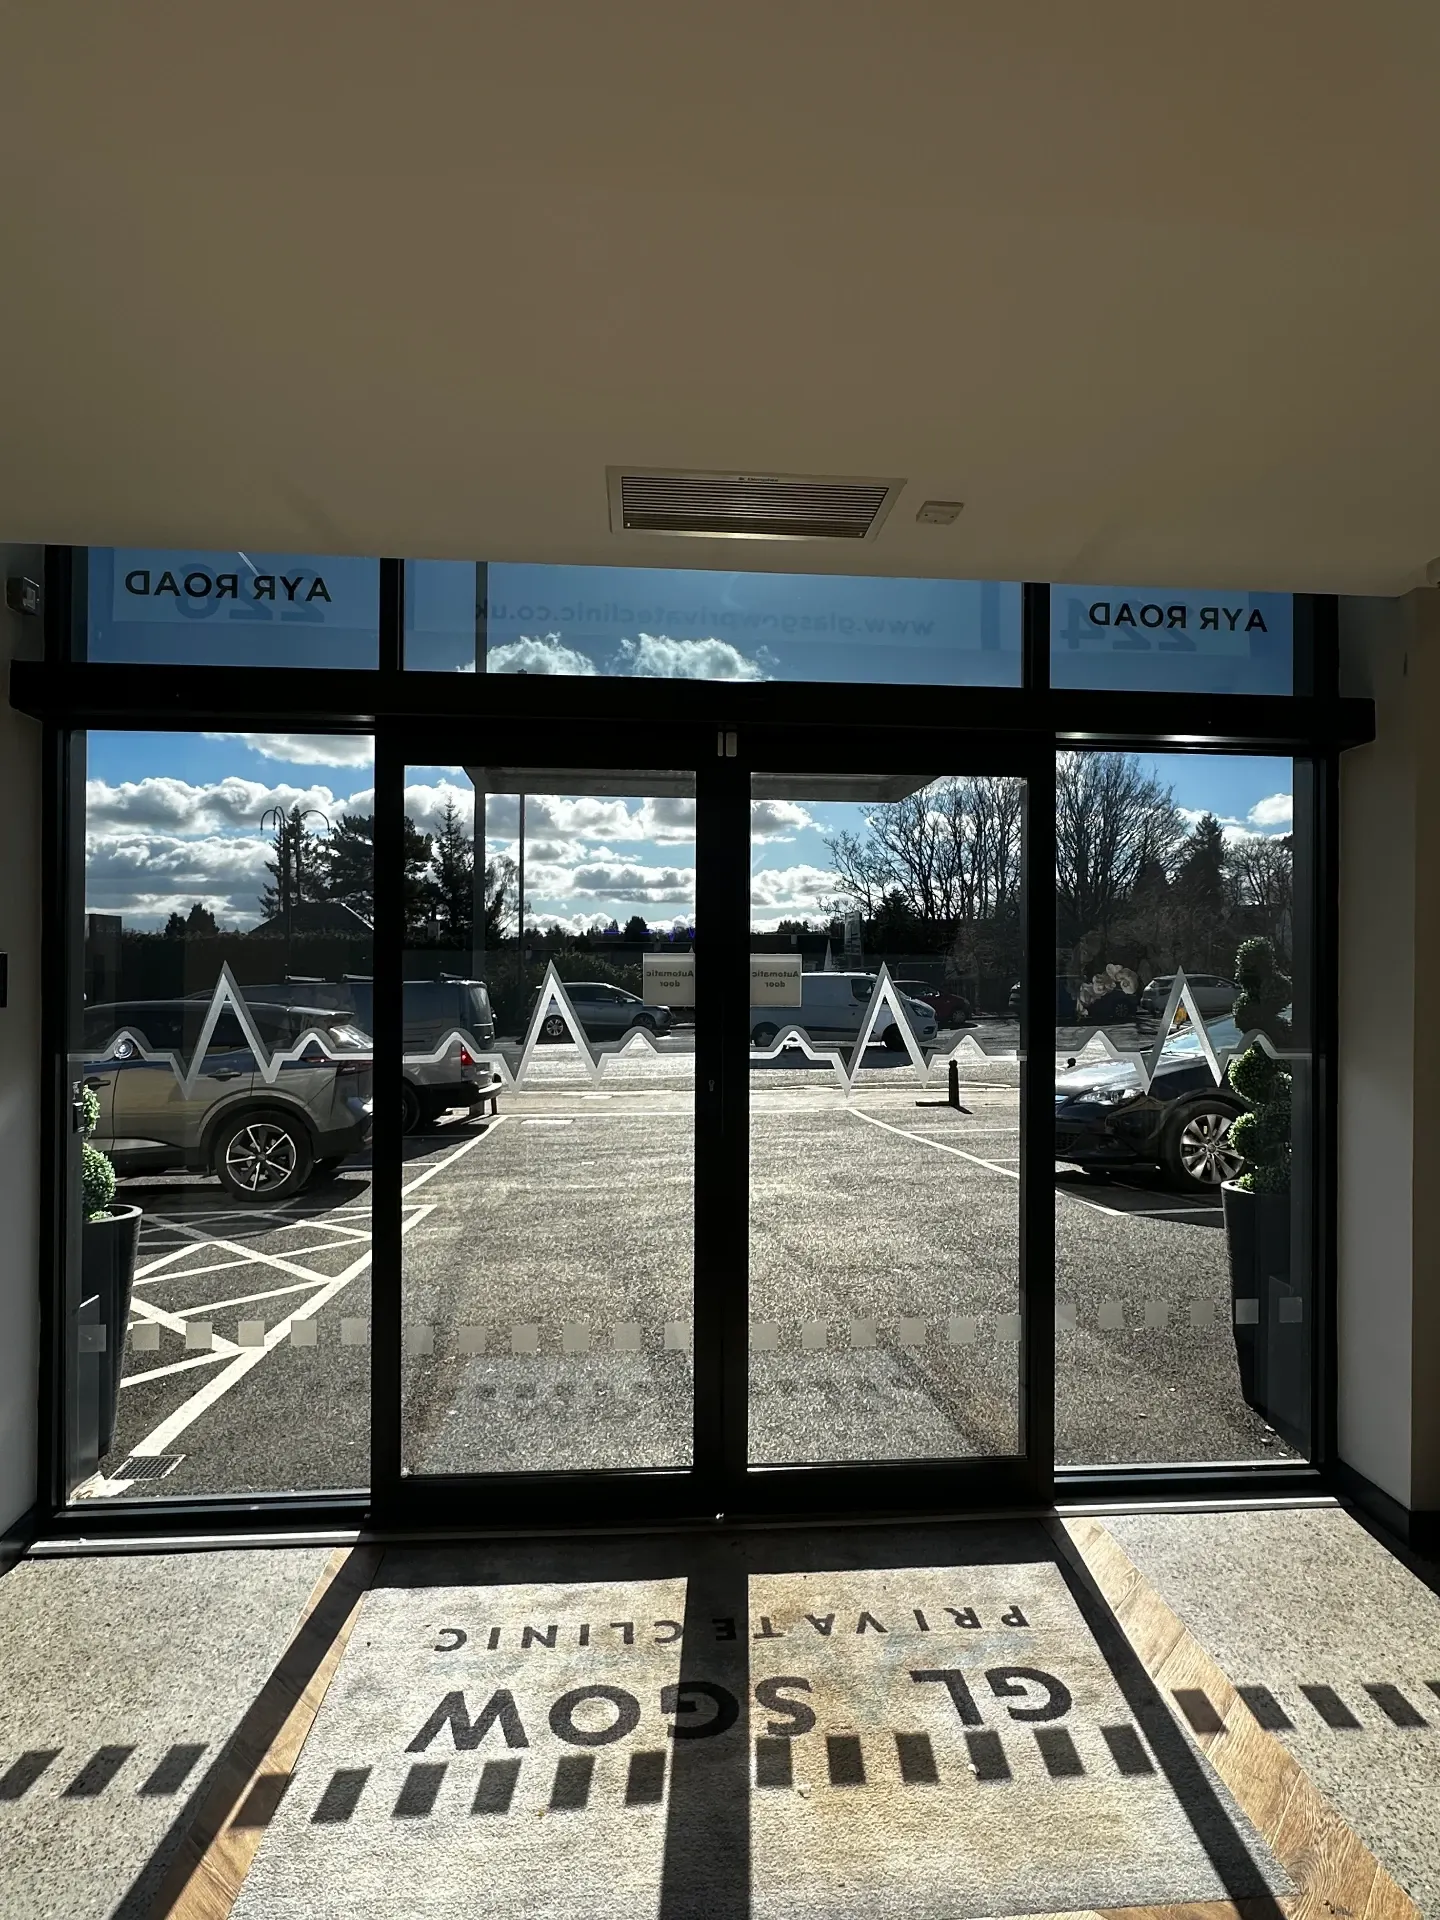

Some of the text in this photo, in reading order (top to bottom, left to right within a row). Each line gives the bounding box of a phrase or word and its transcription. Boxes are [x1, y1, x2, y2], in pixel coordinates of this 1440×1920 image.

[432, 1603, 1028, 1653] PRIVATE CLINIC
[404, 1665, 1074, 1754] GLSGOW
